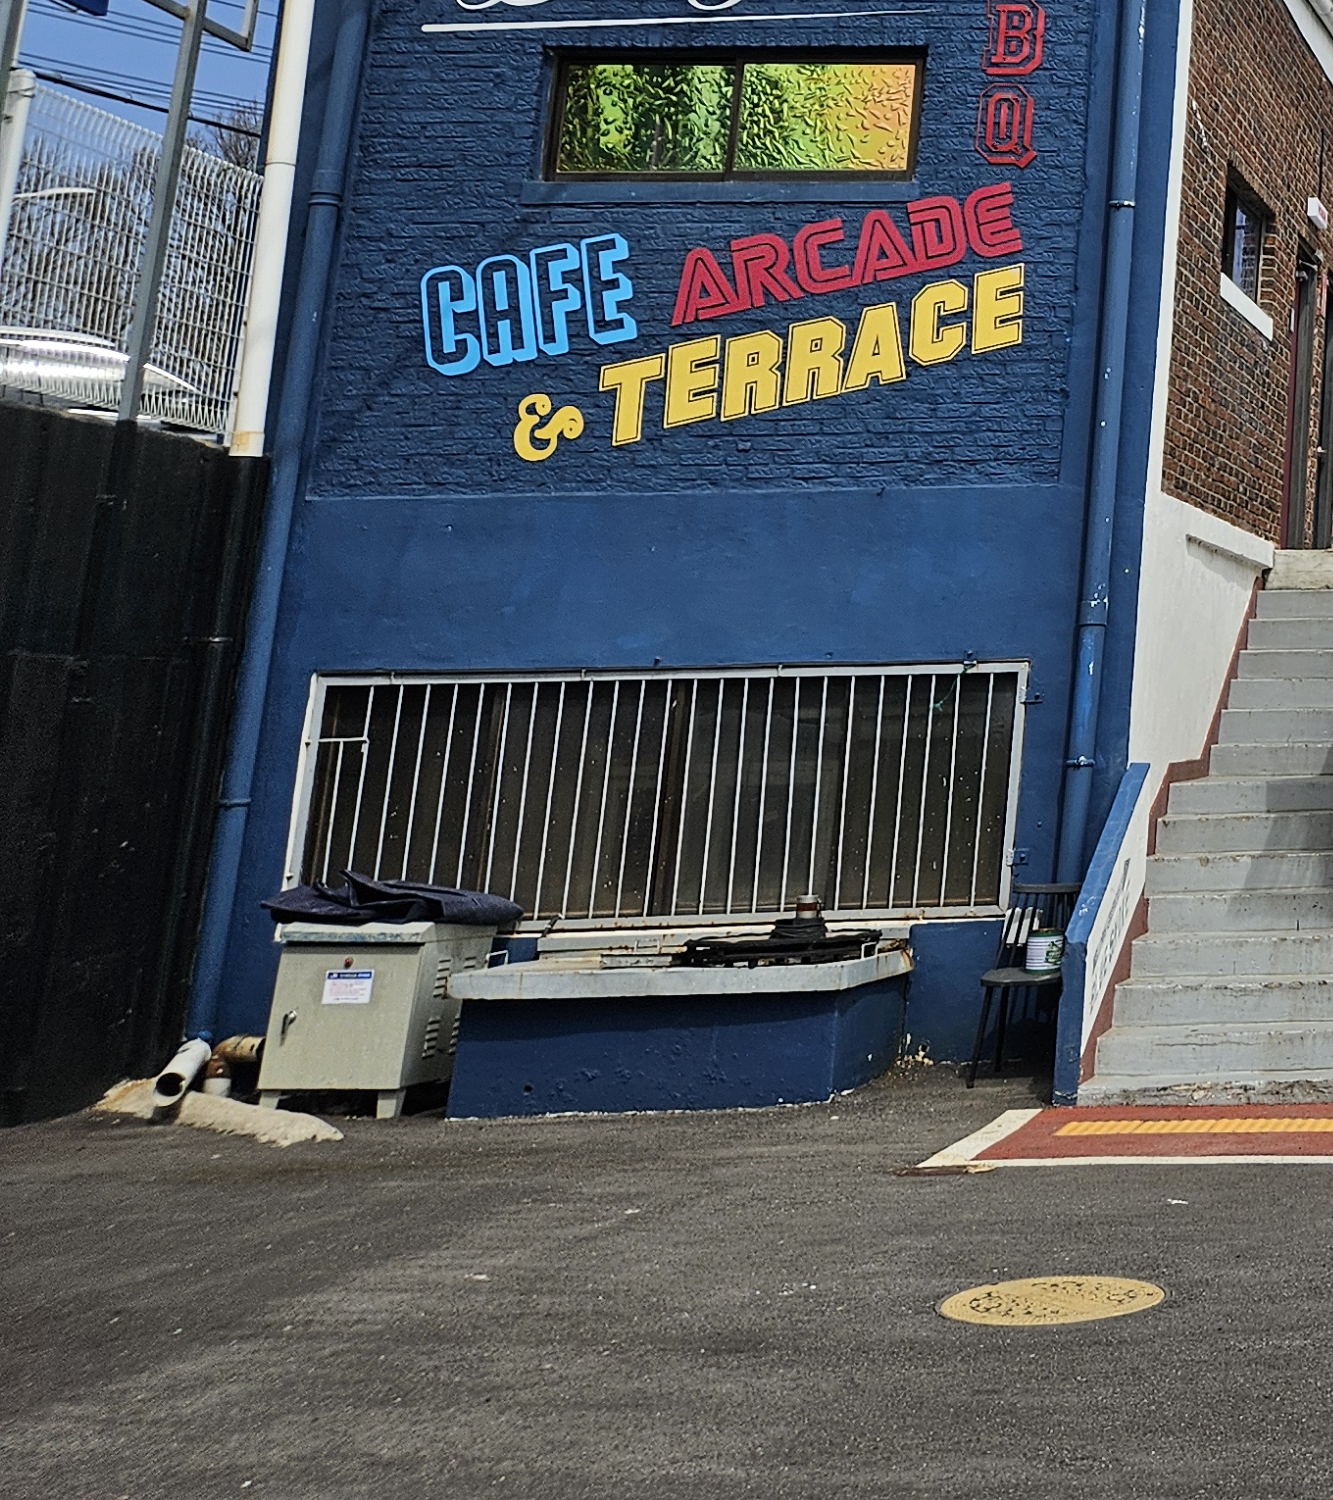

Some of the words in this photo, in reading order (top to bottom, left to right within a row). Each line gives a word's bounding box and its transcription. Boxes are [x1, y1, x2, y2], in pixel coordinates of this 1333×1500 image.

[419, 231, 638, 377] CAFE
[670, 182, 1023, 327] ARCADE
[512, 392, 585, 462] &
[598, 261, 1025, 447] TERRACE
